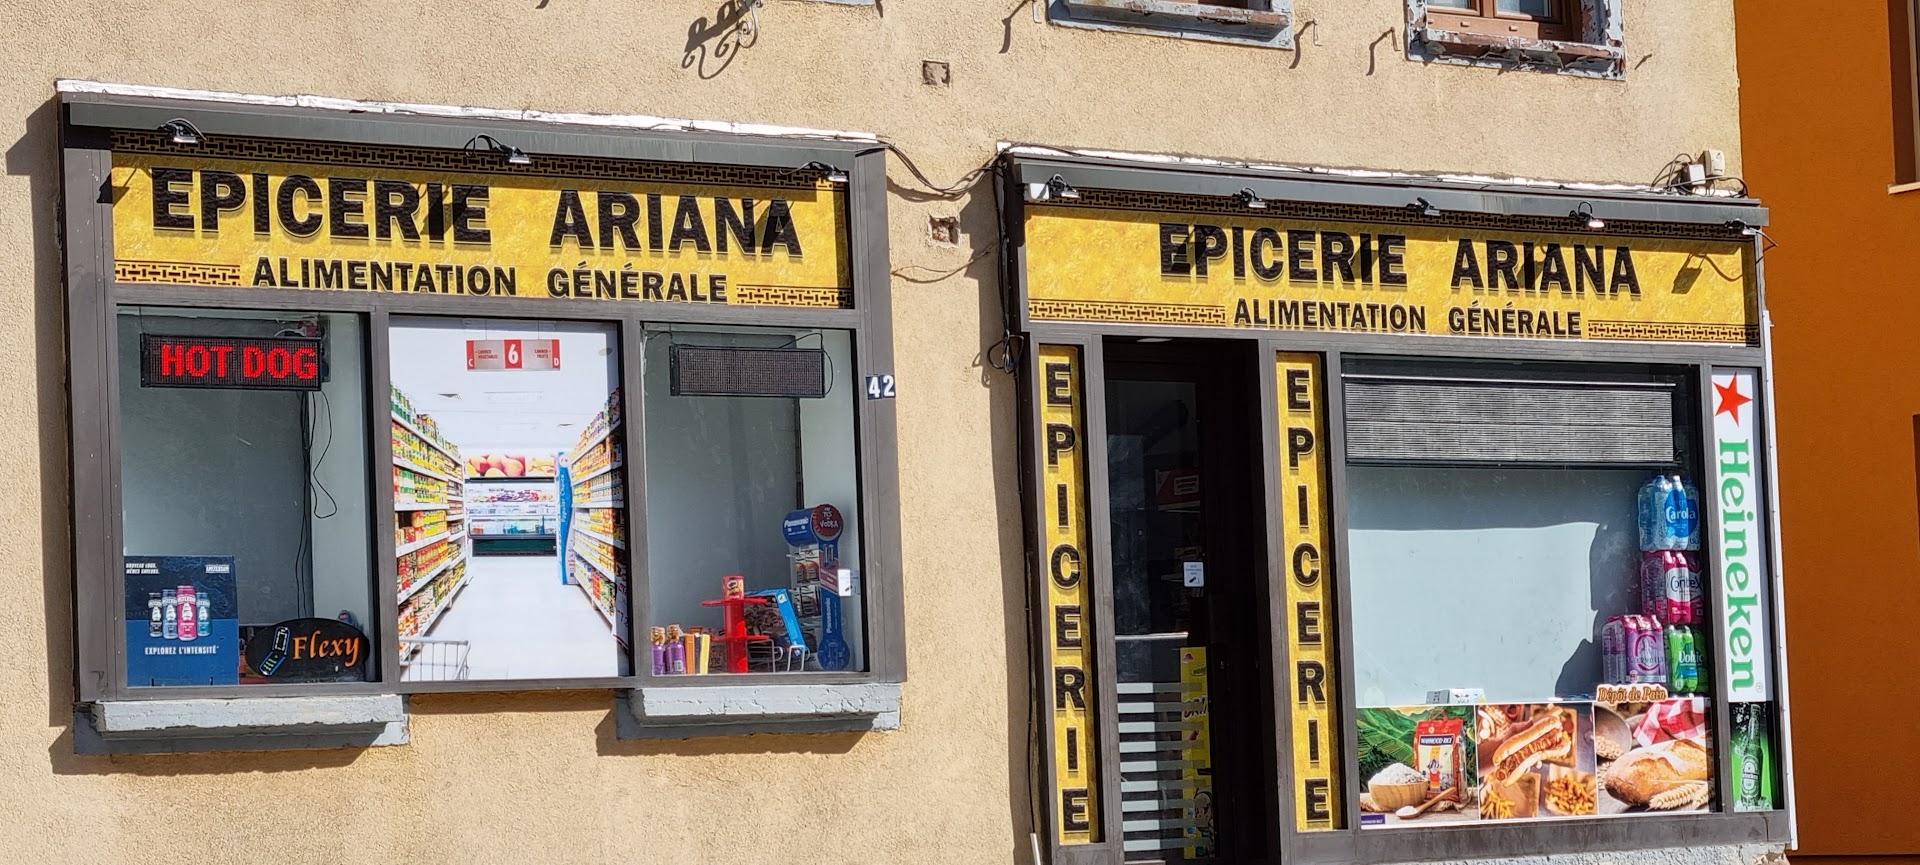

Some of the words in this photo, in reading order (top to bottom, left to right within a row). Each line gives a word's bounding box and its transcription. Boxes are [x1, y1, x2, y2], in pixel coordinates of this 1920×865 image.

[151, 167, 492, 245] EPICERIE
[549, 189, 803, 258] ARIANA
[1159, 222, 1408, 286] EPICERIE
[1451, 238, 1642, 297] ARIANA
[252, 257, 517, 297] ALIMENTATION
[547, 261, 728, 302] GÉNÉRALE
[1234, 299, 1427, 334] ALIMENTATION
[1449, 301, 1582, 336] GÉNÉRALE
[161, 344, 233, 380] HOT
[243, 346, 319, 381] DOG
[508, 343, 519, 365] 6
[553, 357, 559, 366] D
[867, 375, 895, 399] 42
[783, 517, 809, 528] Panasonic
[1665, 505, 1697, 524] Carola
[1718, 437, 1759, 692] Heineken
[1045, 362, 1091, 833] EPICERIE
[1286, 368, 1331, 823] EPICERIE
[144, 646, 177, 655] EXPLOREZ
[292, 630, 360, 667] Flexy
[1598, 686, 1627, 704] Dépôt
[1629, 687, 1641, 700] de
[1642, 687, 1667, 700] Pain
